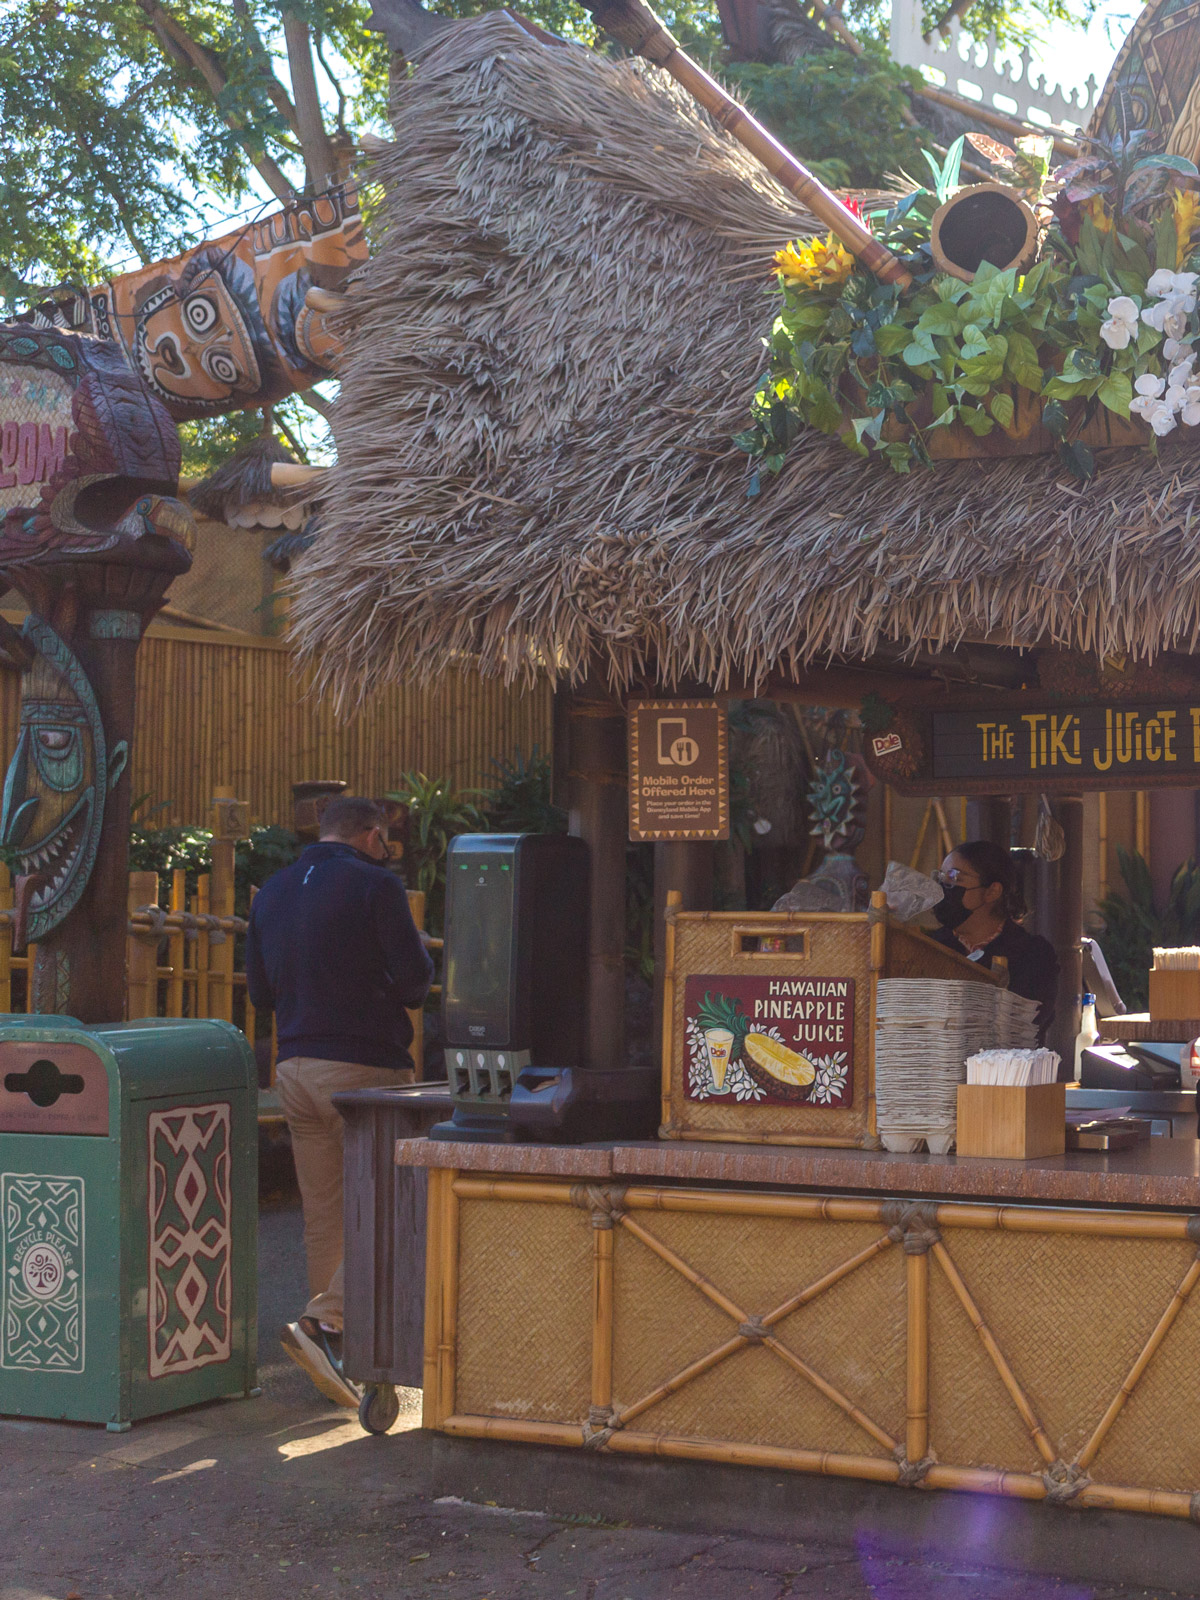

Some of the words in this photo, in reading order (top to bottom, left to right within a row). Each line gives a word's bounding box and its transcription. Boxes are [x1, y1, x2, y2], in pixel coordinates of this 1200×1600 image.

[0, 420, 67, 489] OOM
[874, 735, 900, 751] Dole
[976, 723, 1015, 761] THE
[642, 776, 679, 786] Mobile
[680, 775, 715, 785] Order
[641, 786, 687, 797] Offered
[688, 786, 716, 796] Here
[769, 981, 848, 997] HAWAIIAN
[754, 1000, 845, 1020] PINEAPPLE
[792, 1024, 844, 1042] JUICE
[13, 1231, 43, 1262] RECYCLE
[45, 1231, 74, 1266] PLEASE
